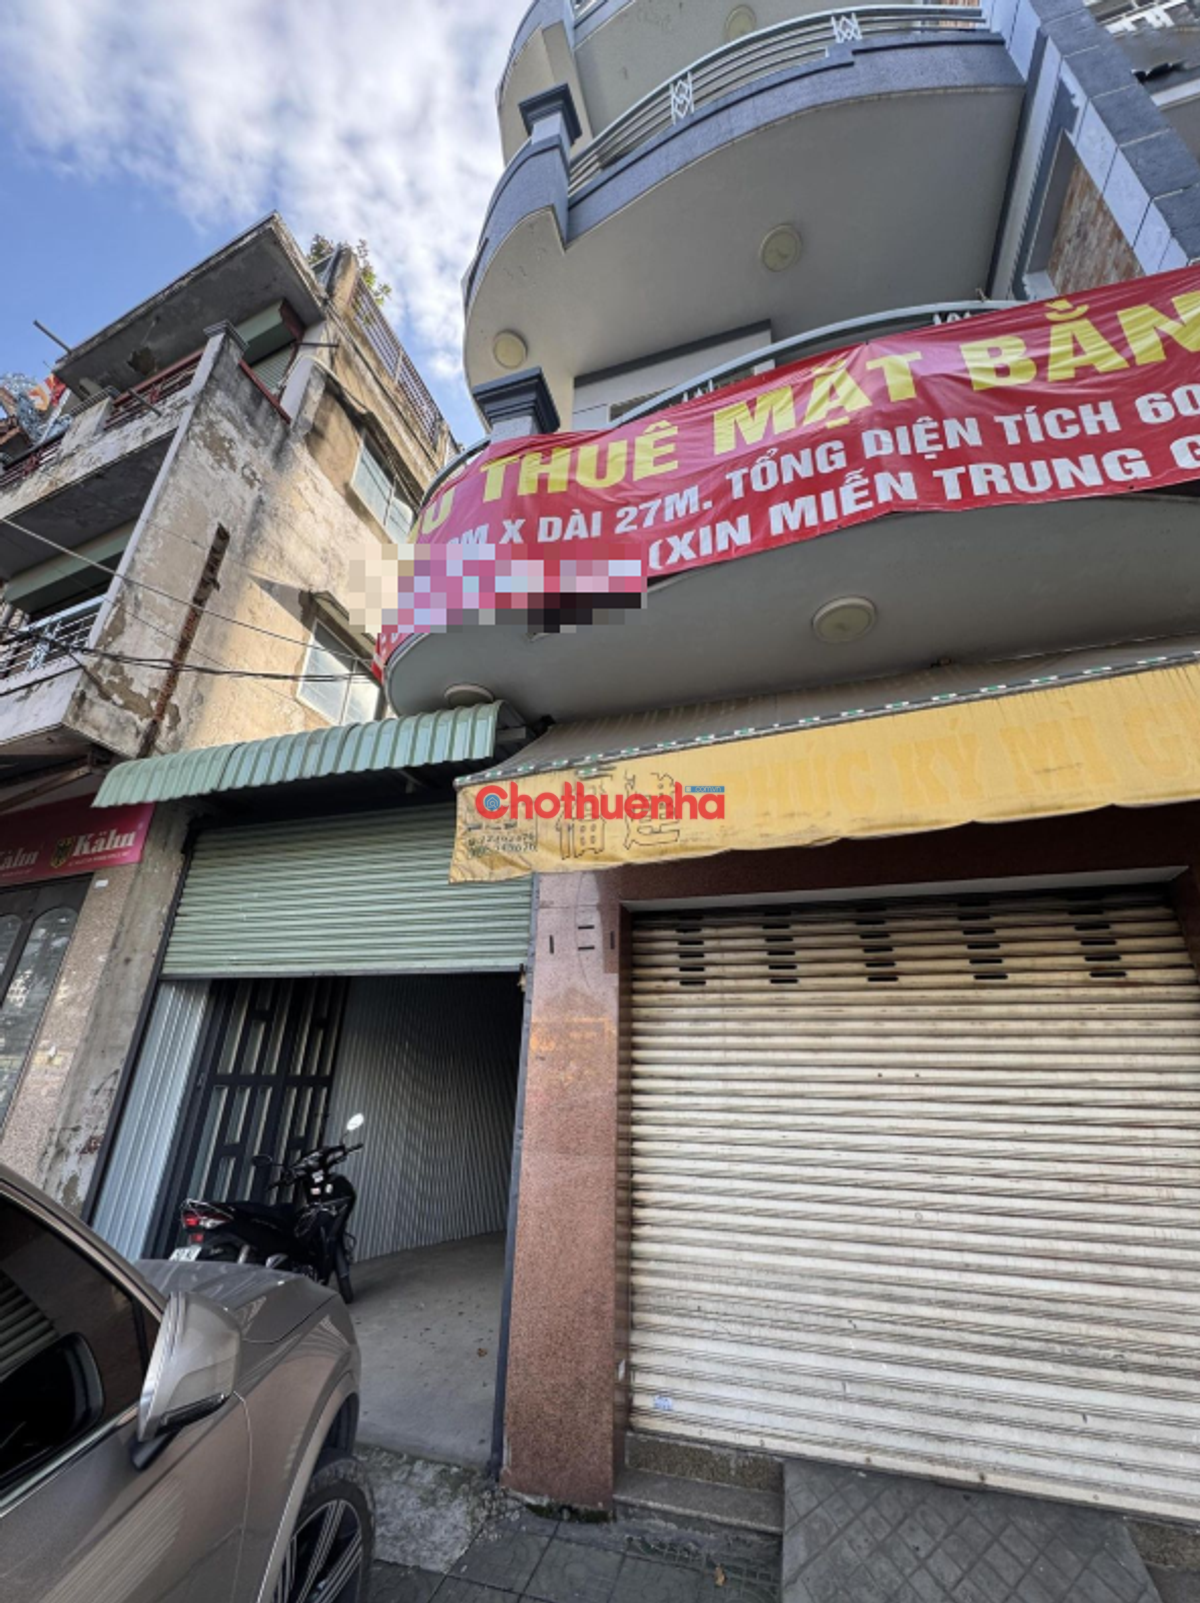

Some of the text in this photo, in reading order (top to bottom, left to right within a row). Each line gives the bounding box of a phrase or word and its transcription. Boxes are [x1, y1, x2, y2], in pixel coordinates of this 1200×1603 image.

[480, 420, 679, 503] THUÊ
[713, 351, 924, 456] MẶT
[499, 518, 527, 545] X
[537, 510, 603, 544] DÀI
[614, 484, 713, 535] 27M.
[726, 439, 848, 500] TỔNG
[861, 414, 983, 461] DIỆN
[994, 403, 1122, 446] TÍCH
[648, 514, 752, 571] (XIN
[768, 466, 918, 537] MIỄN
[933, 447, 1152, 501] TRUNG
